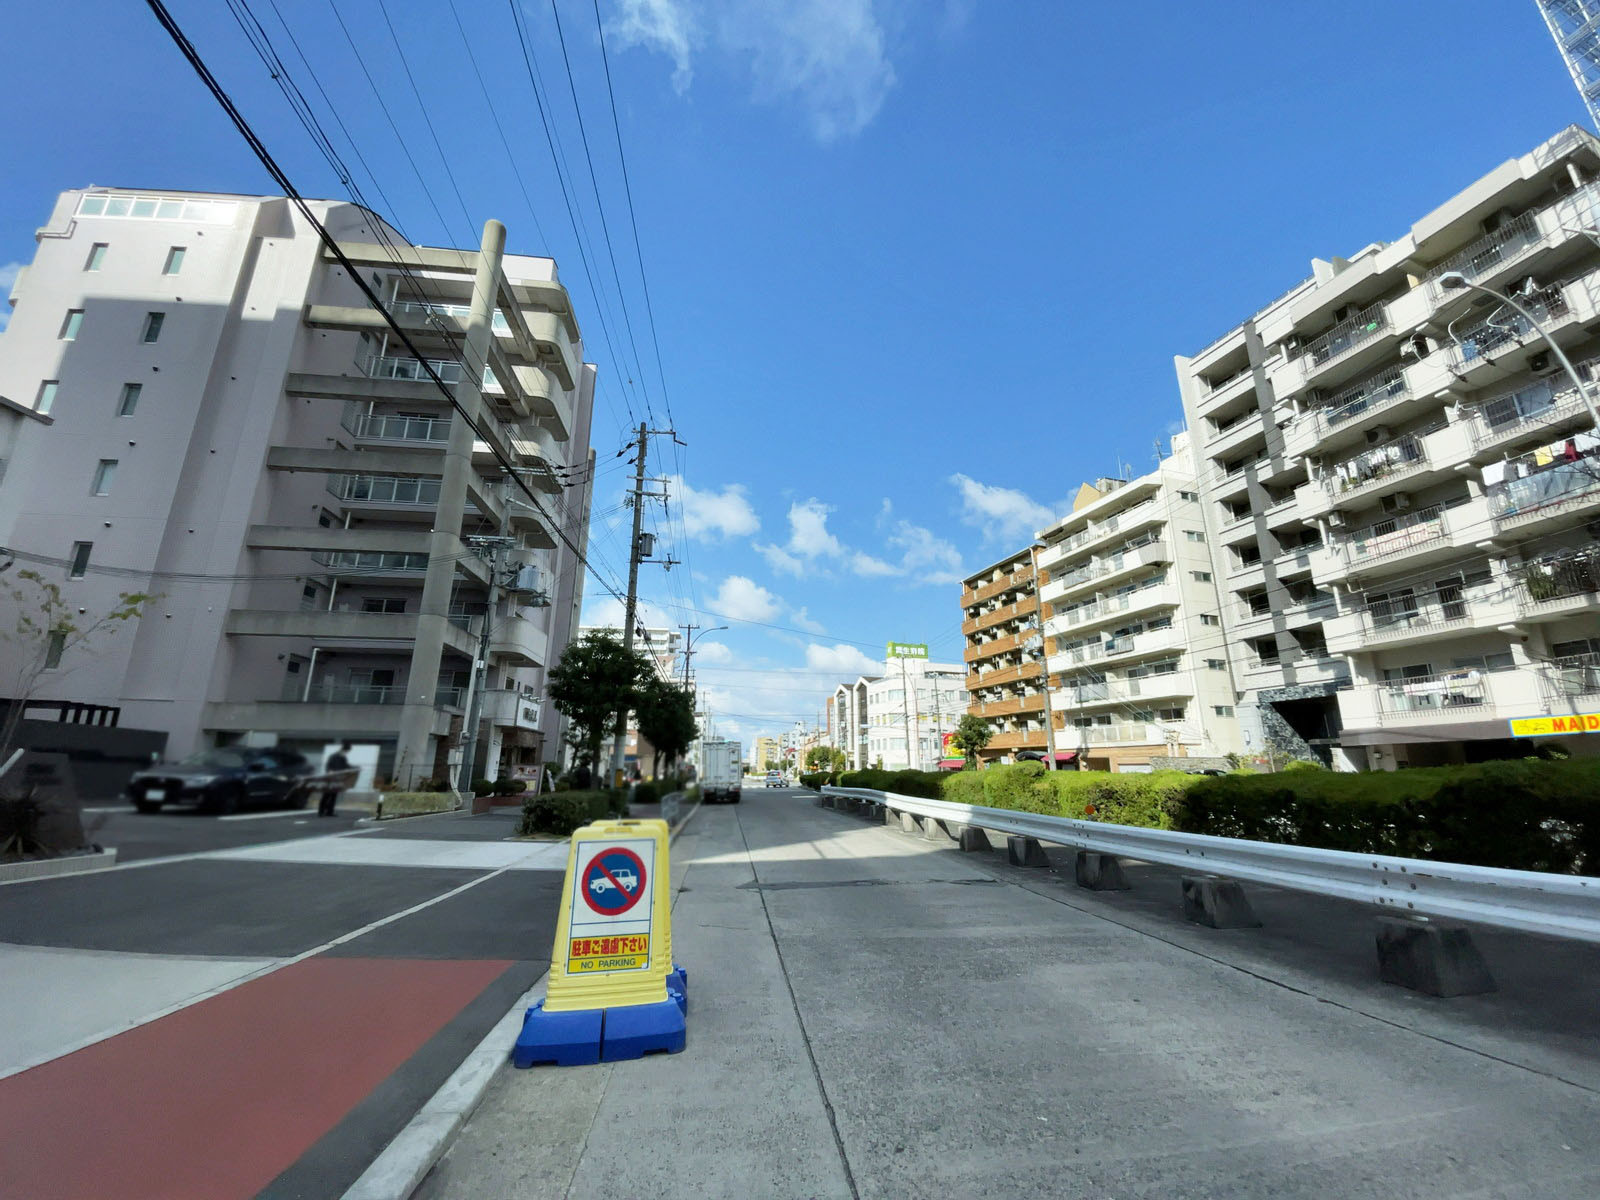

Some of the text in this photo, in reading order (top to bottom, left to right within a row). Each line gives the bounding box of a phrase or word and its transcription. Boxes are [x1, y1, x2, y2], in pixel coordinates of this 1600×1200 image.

[1552, 715, 1600, 732] MAID
[572, 937, 647, 957] 駐車ご遠慮下さい
[580, 957, 636, 969] NO PARKING
